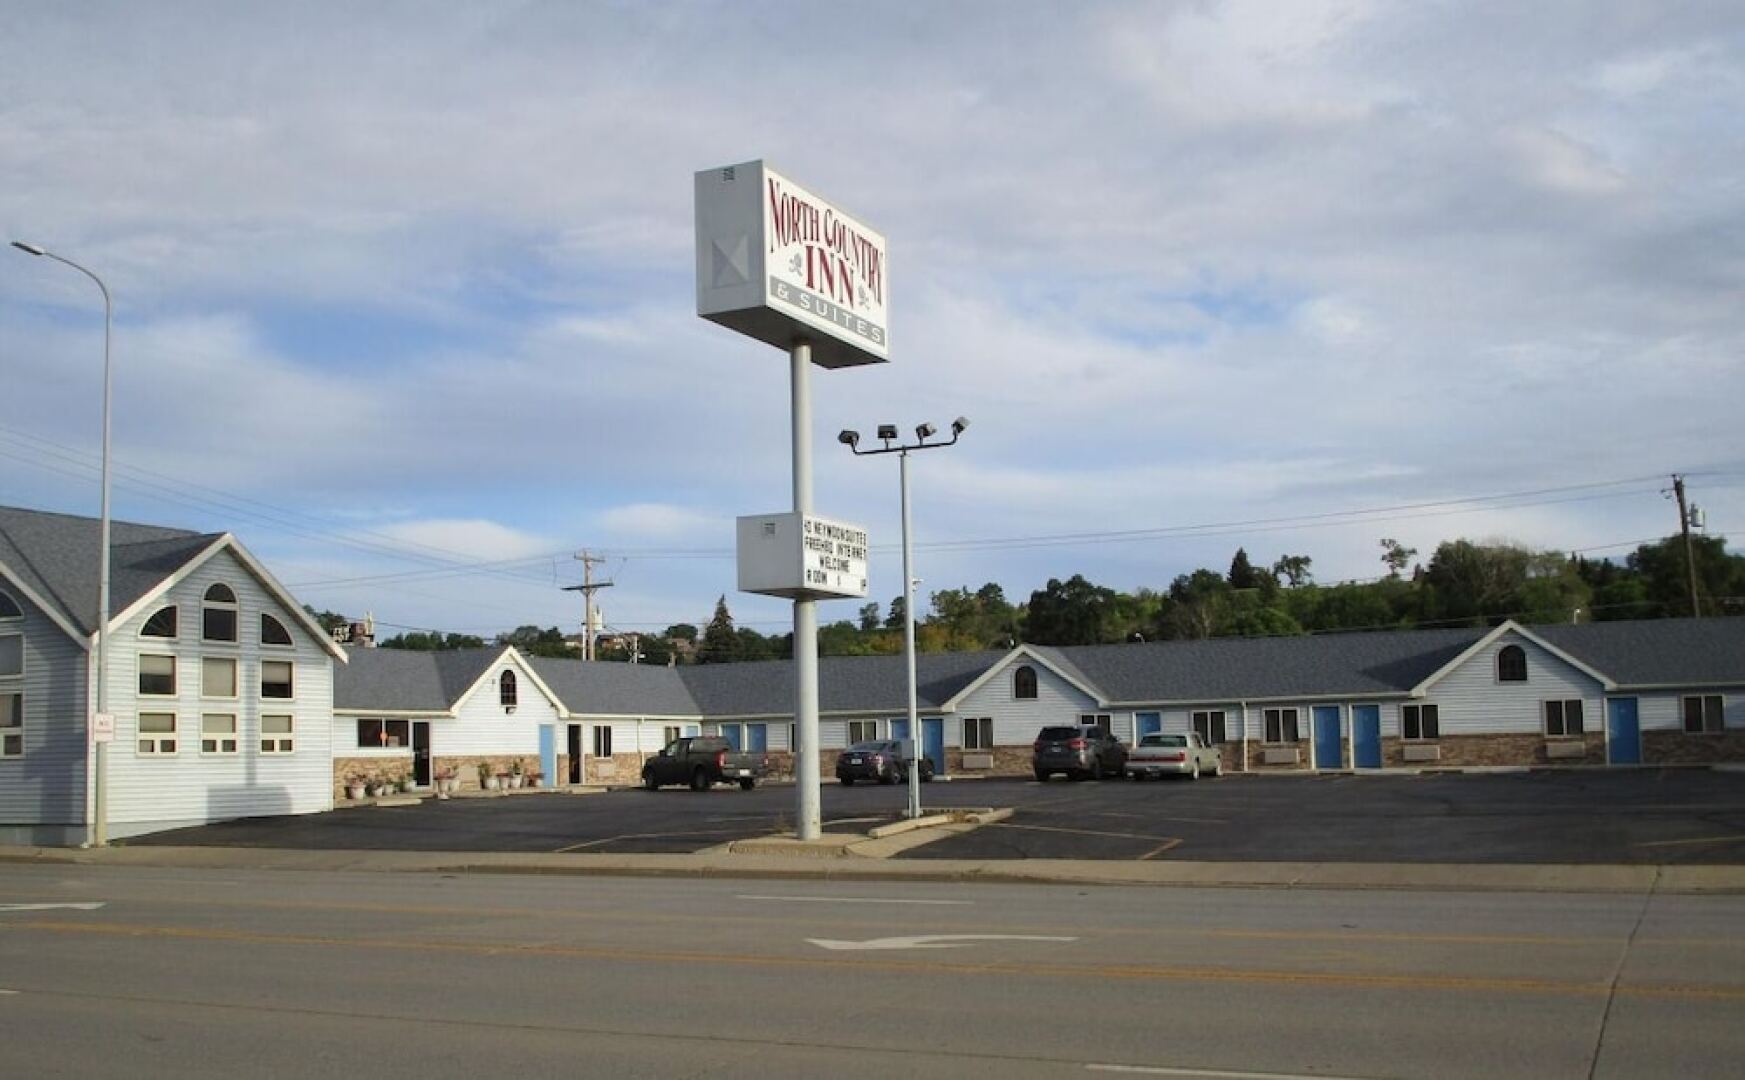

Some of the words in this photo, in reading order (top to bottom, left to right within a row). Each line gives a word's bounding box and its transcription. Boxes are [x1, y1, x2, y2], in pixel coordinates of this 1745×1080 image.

[768, 177, 820, 254] NORTH
[824, 208, 884, 307] COUNTRY
[805, 245, 855, 309] INN
[777, 282, 789, 297] &
[800, 293, 882, 343] SUITES
[820, 556, 849, 573] WELCOME
